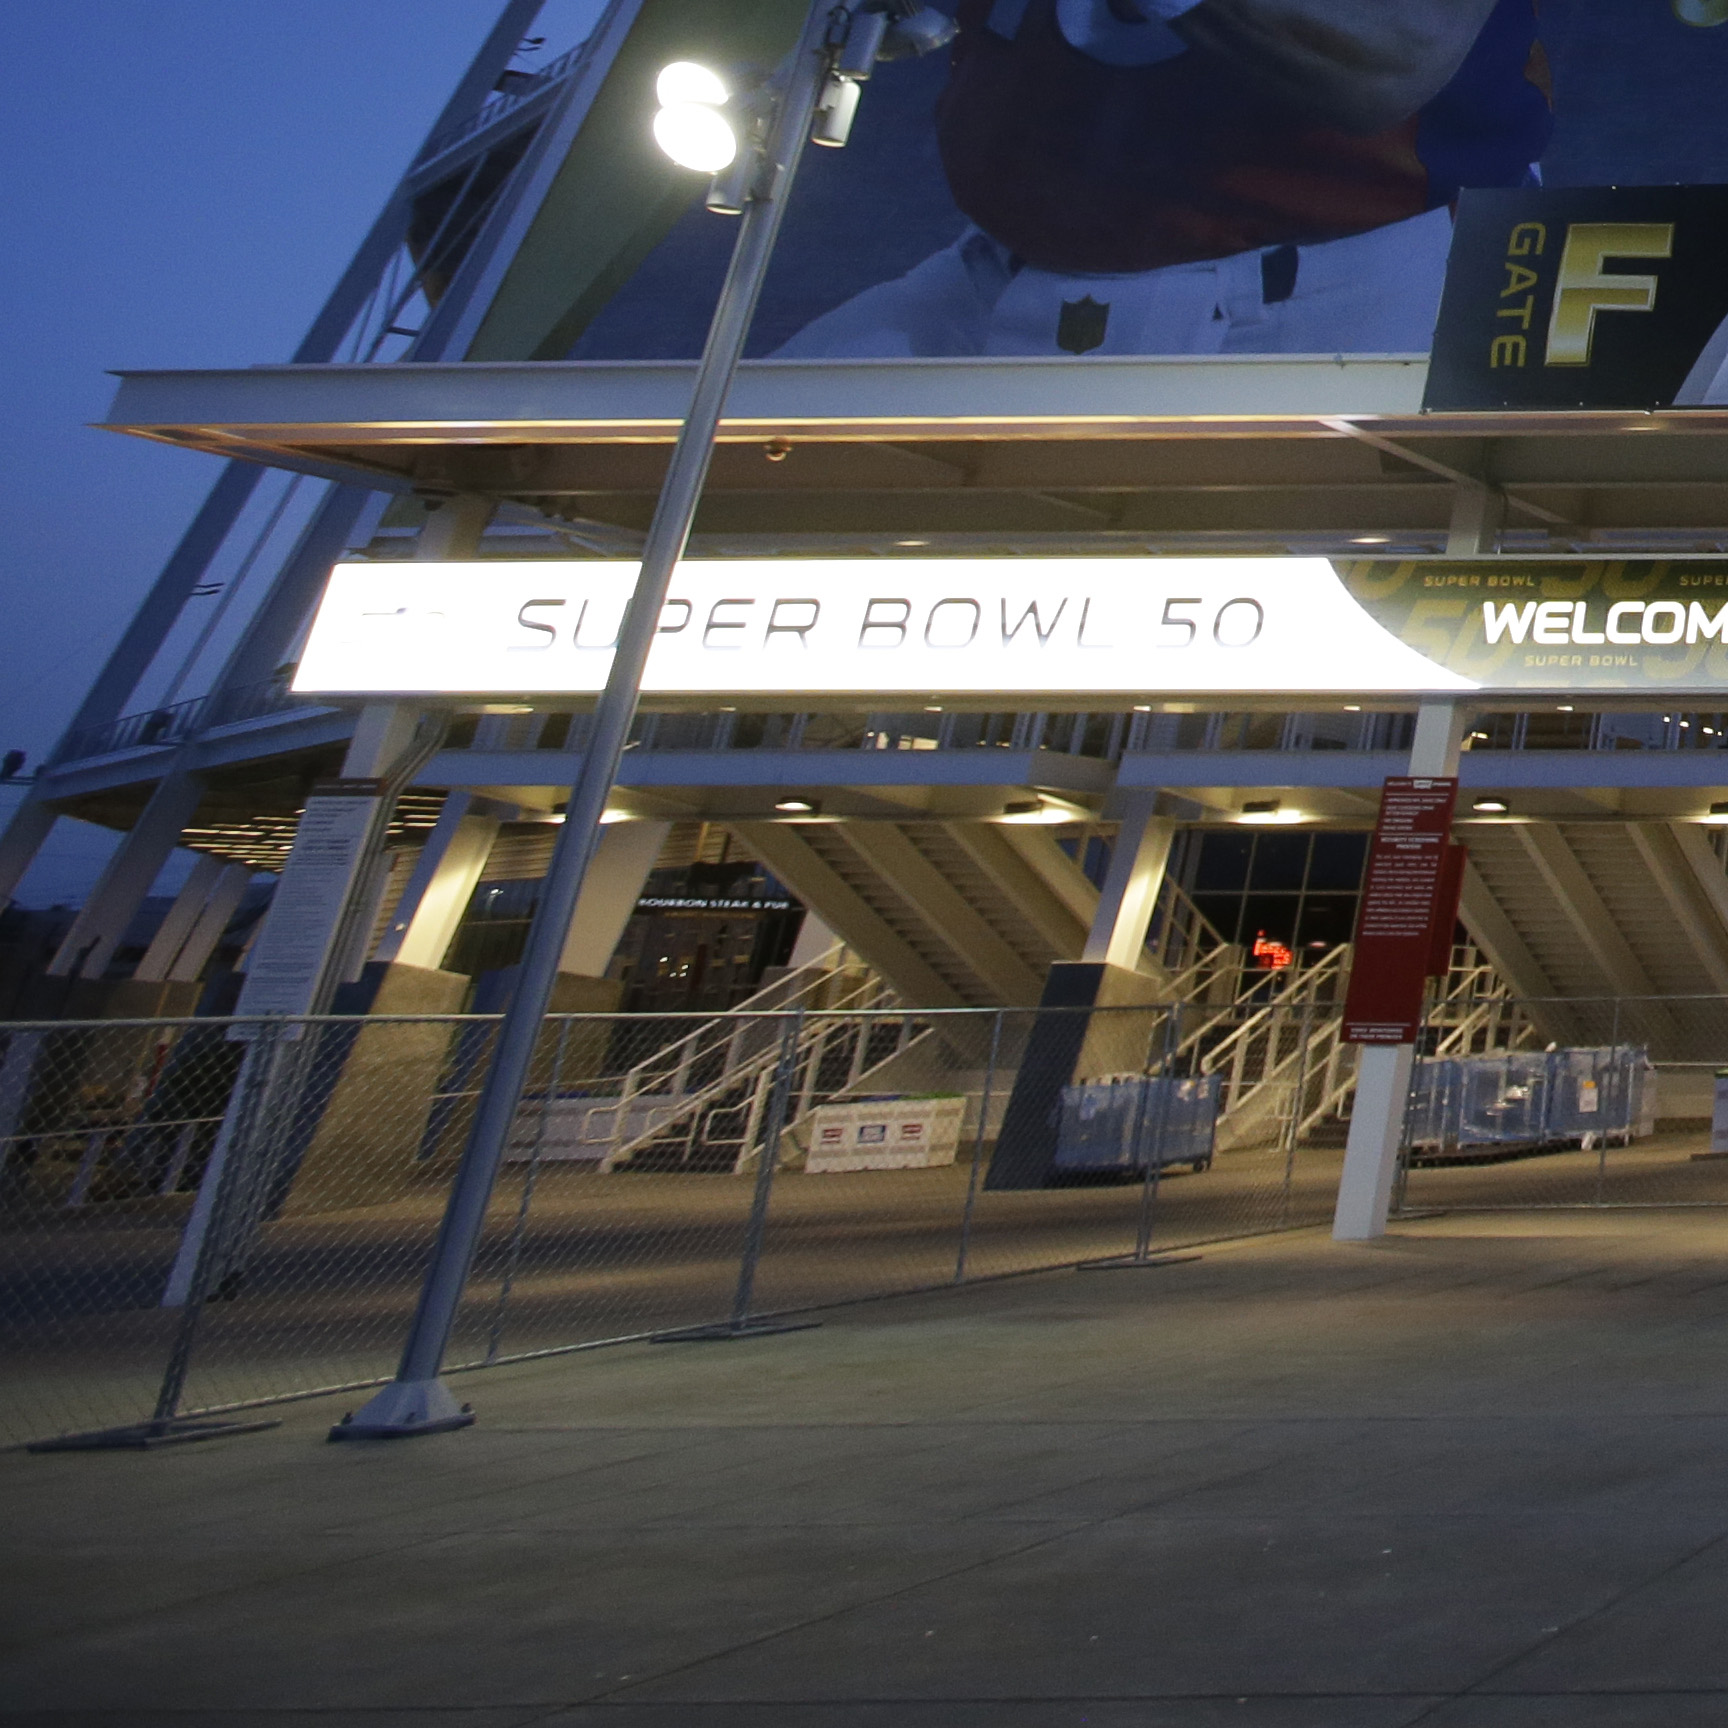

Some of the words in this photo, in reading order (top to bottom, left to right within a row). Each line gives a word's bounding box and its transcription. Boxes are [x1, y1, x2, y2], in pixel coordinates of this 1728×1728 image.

[1488, 221, 1546, 369] GATE
[1543, 221, 1676, 368] F
[1424, 575, 1479, 587] SUPER
[1487, 575, 1536, 587] BOWL
[508, 597, 823, 653] SUPER
[856, 596, 1114, 651] BOWL
[1156, 596, 1266, 650] 50
[1524, 655, 1582, 667] SUPER
[1588, 654, 1638, 667] BOWL
